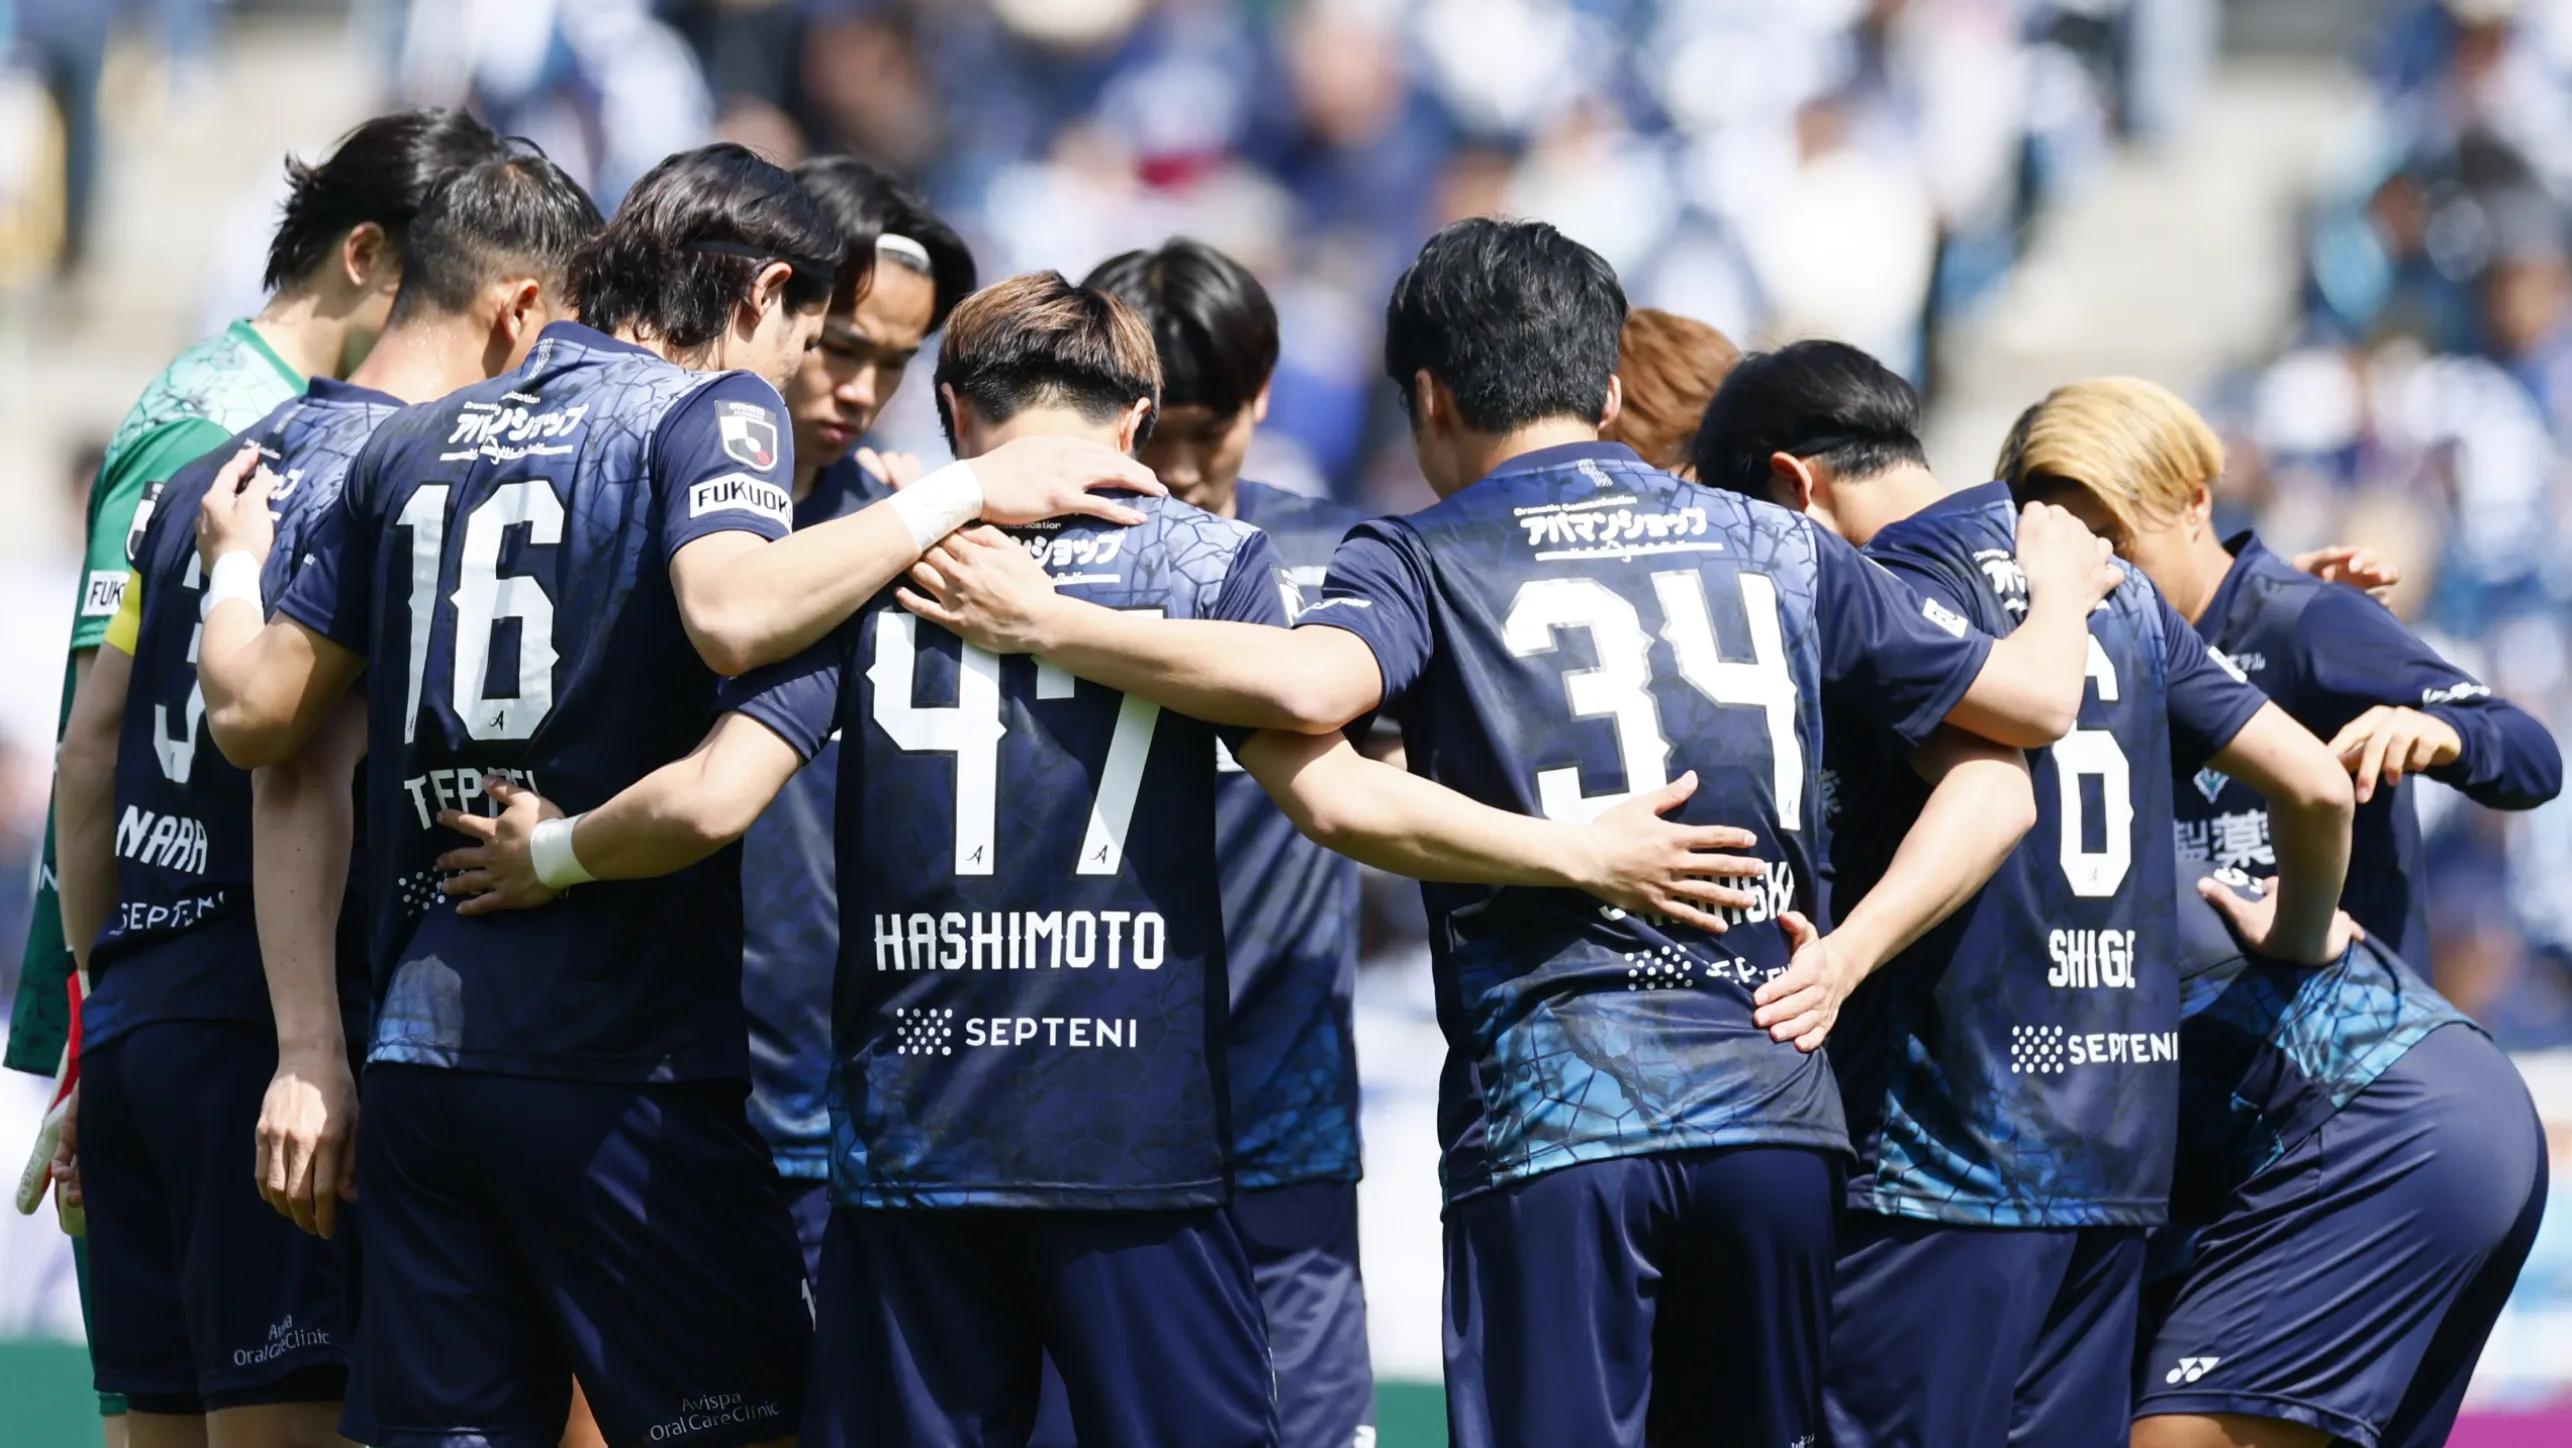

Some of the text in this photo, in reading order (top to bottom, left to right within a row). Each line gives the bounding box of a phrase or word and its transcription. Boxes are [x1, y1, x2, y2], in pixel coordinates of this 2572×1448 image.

[1520, 507, 1707, 546] アパマンショップ
[396, 480, 565, 744] 16
[1501, 569, 1801, 831] 34
[866, 609, 1165, 875] 47
[115, 804, 208, 875] NARA
[874, 910, 1165, 971] HASHIMOTO
[965, 1018, 1137, 1047] SEPTENI
[2068, 1032, 2178, 1064] SEPTENI
[233, 1344, 268, 1366] Oral
[286, 1329, 331, 1349] Clinic
[650, 1400, 781, 1441] Oral Care Clinic
[682, 1393, 742, 1412] Avispa
